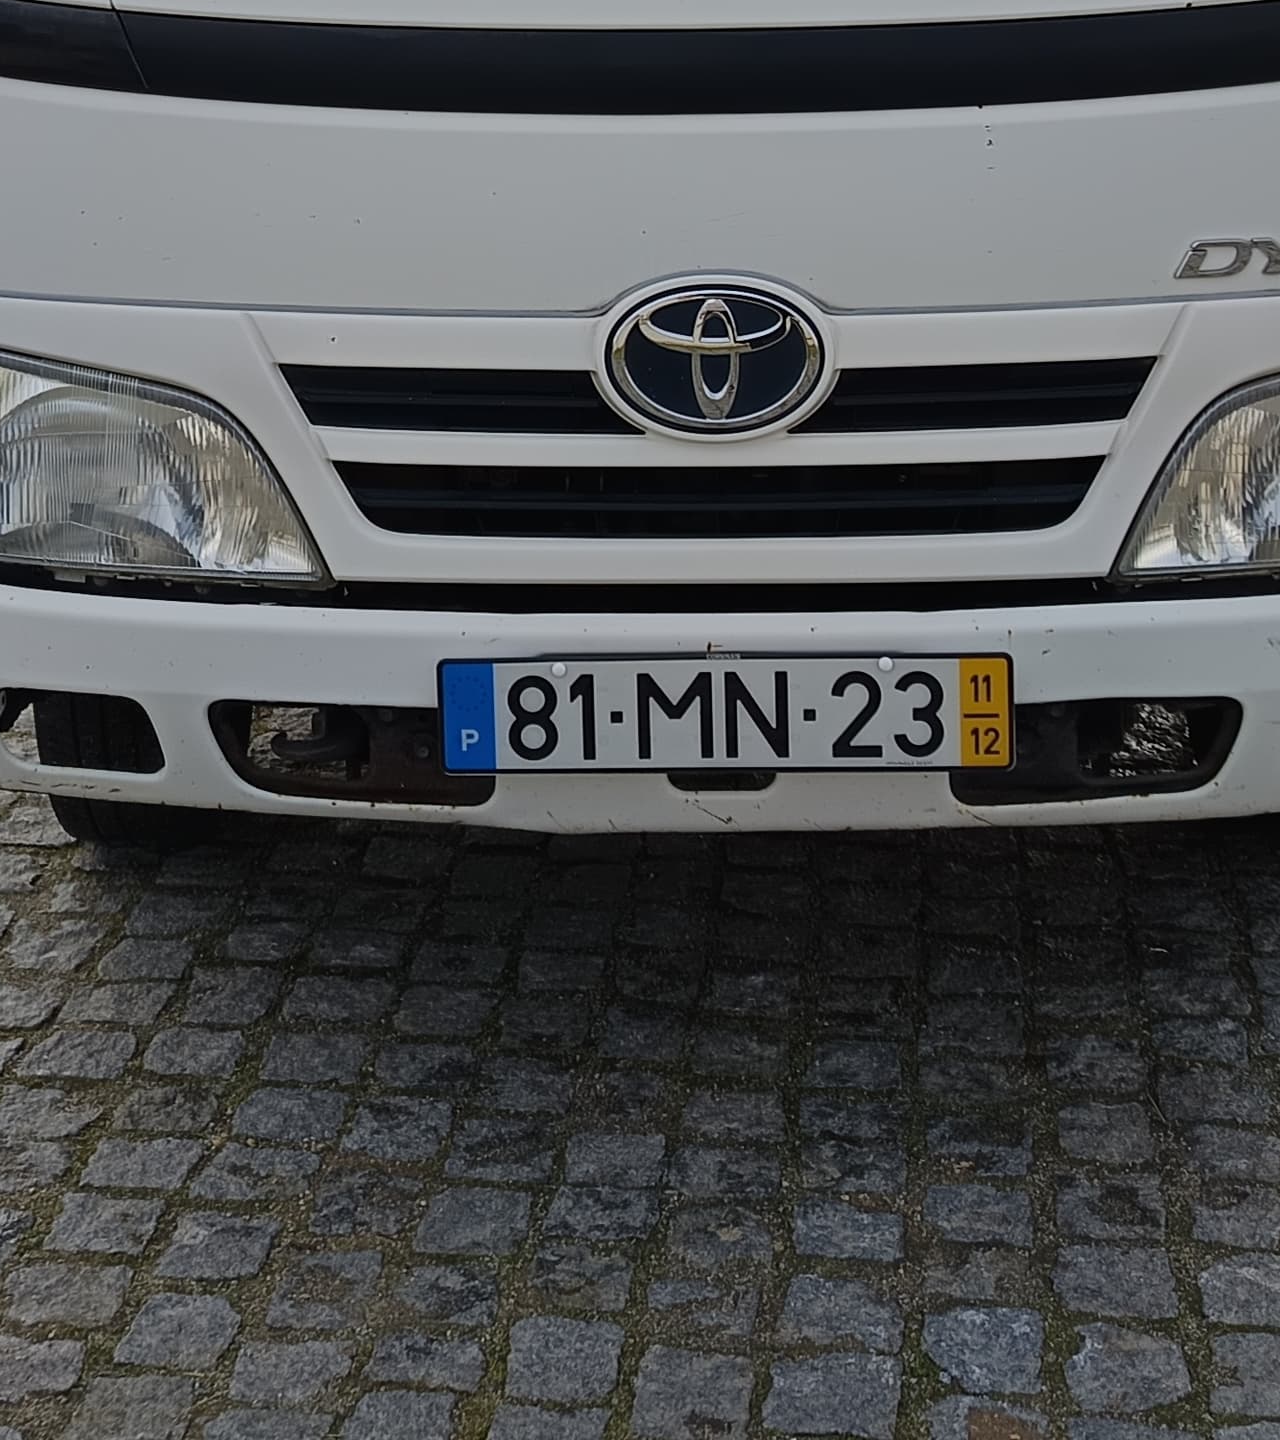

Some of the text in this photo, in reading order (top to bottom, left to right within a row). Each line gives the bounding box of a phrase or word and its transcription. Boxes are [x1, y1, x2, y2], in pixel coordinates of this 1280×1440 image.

[970, 674, 991, 703] 11
[461, 729, 480, 751] P
[970, 727, 1001, 755] 12
